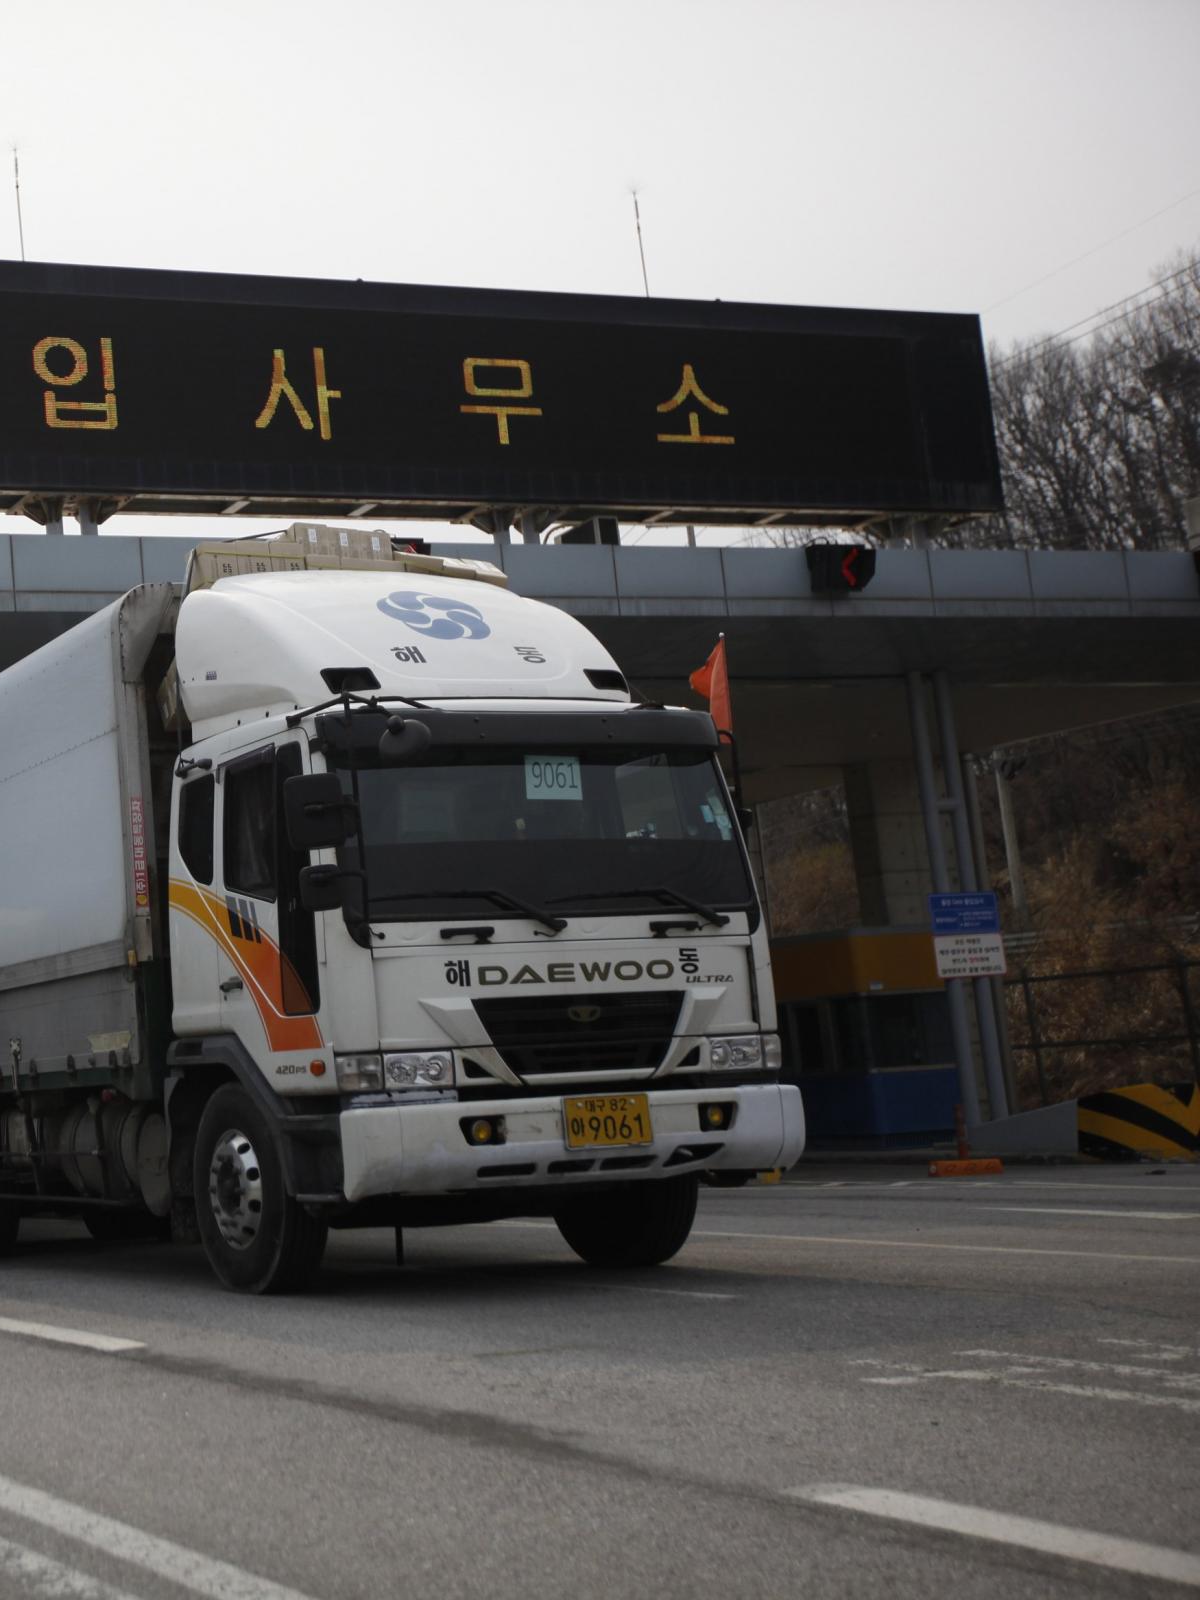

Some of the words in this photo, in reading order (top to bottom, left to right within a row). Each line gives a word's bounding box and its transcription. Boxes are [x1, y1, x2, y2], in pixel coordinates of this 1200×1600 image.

[390, 646, 427, 663] 해
[532, 762, 578, 788] 9061
[444, 960, 472, 987] 해
[477, 959, 675, 986] DAEWOO
[678, 947, 700, 975] 동
[685, 975, 734, 984] ULTRA
[609, 1097, 628, 1111] 82
